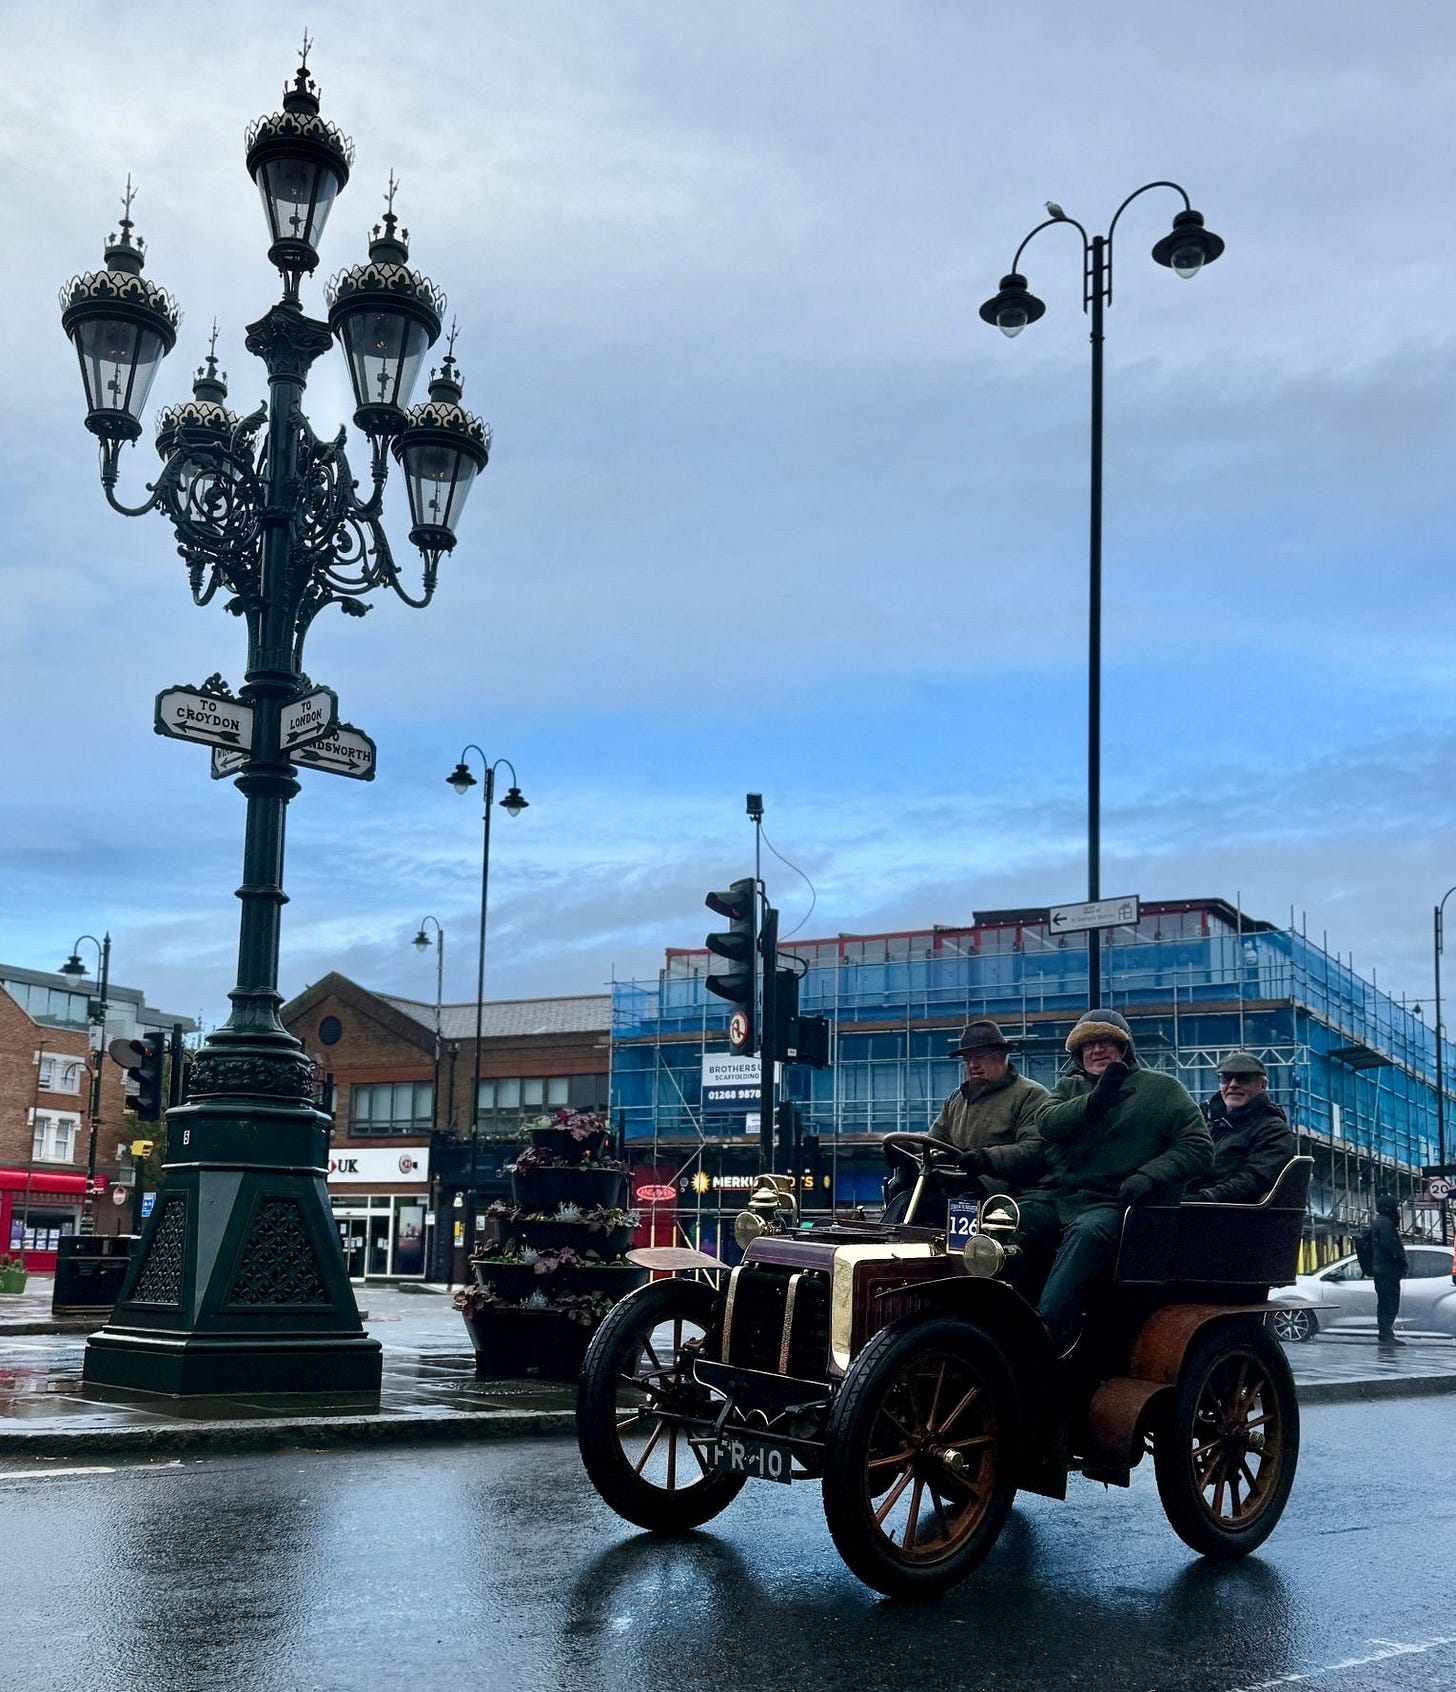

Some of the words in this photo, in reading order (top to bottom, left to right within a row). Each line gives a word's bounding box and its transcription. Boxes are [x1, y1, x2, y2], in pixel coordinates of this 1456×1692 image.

[200, 699, 217, 712] TO
[301, 700, 312, 713] TO
[177, 707, 240, 731] CROYDON
[290, 708, 322, 730] LONDON
[709, 1064, 756, 1073] BROTHERS
[708, 1090, 737, 1100] 01268
[738, 1089, 761, 1099] 9878
[337, 1159, 359, 1173] UK
[712, 1176, 759, 1188] MERKU
[1431, 1184, 1449, 1194] 20
[950, 1216, 978, 1236] 126
